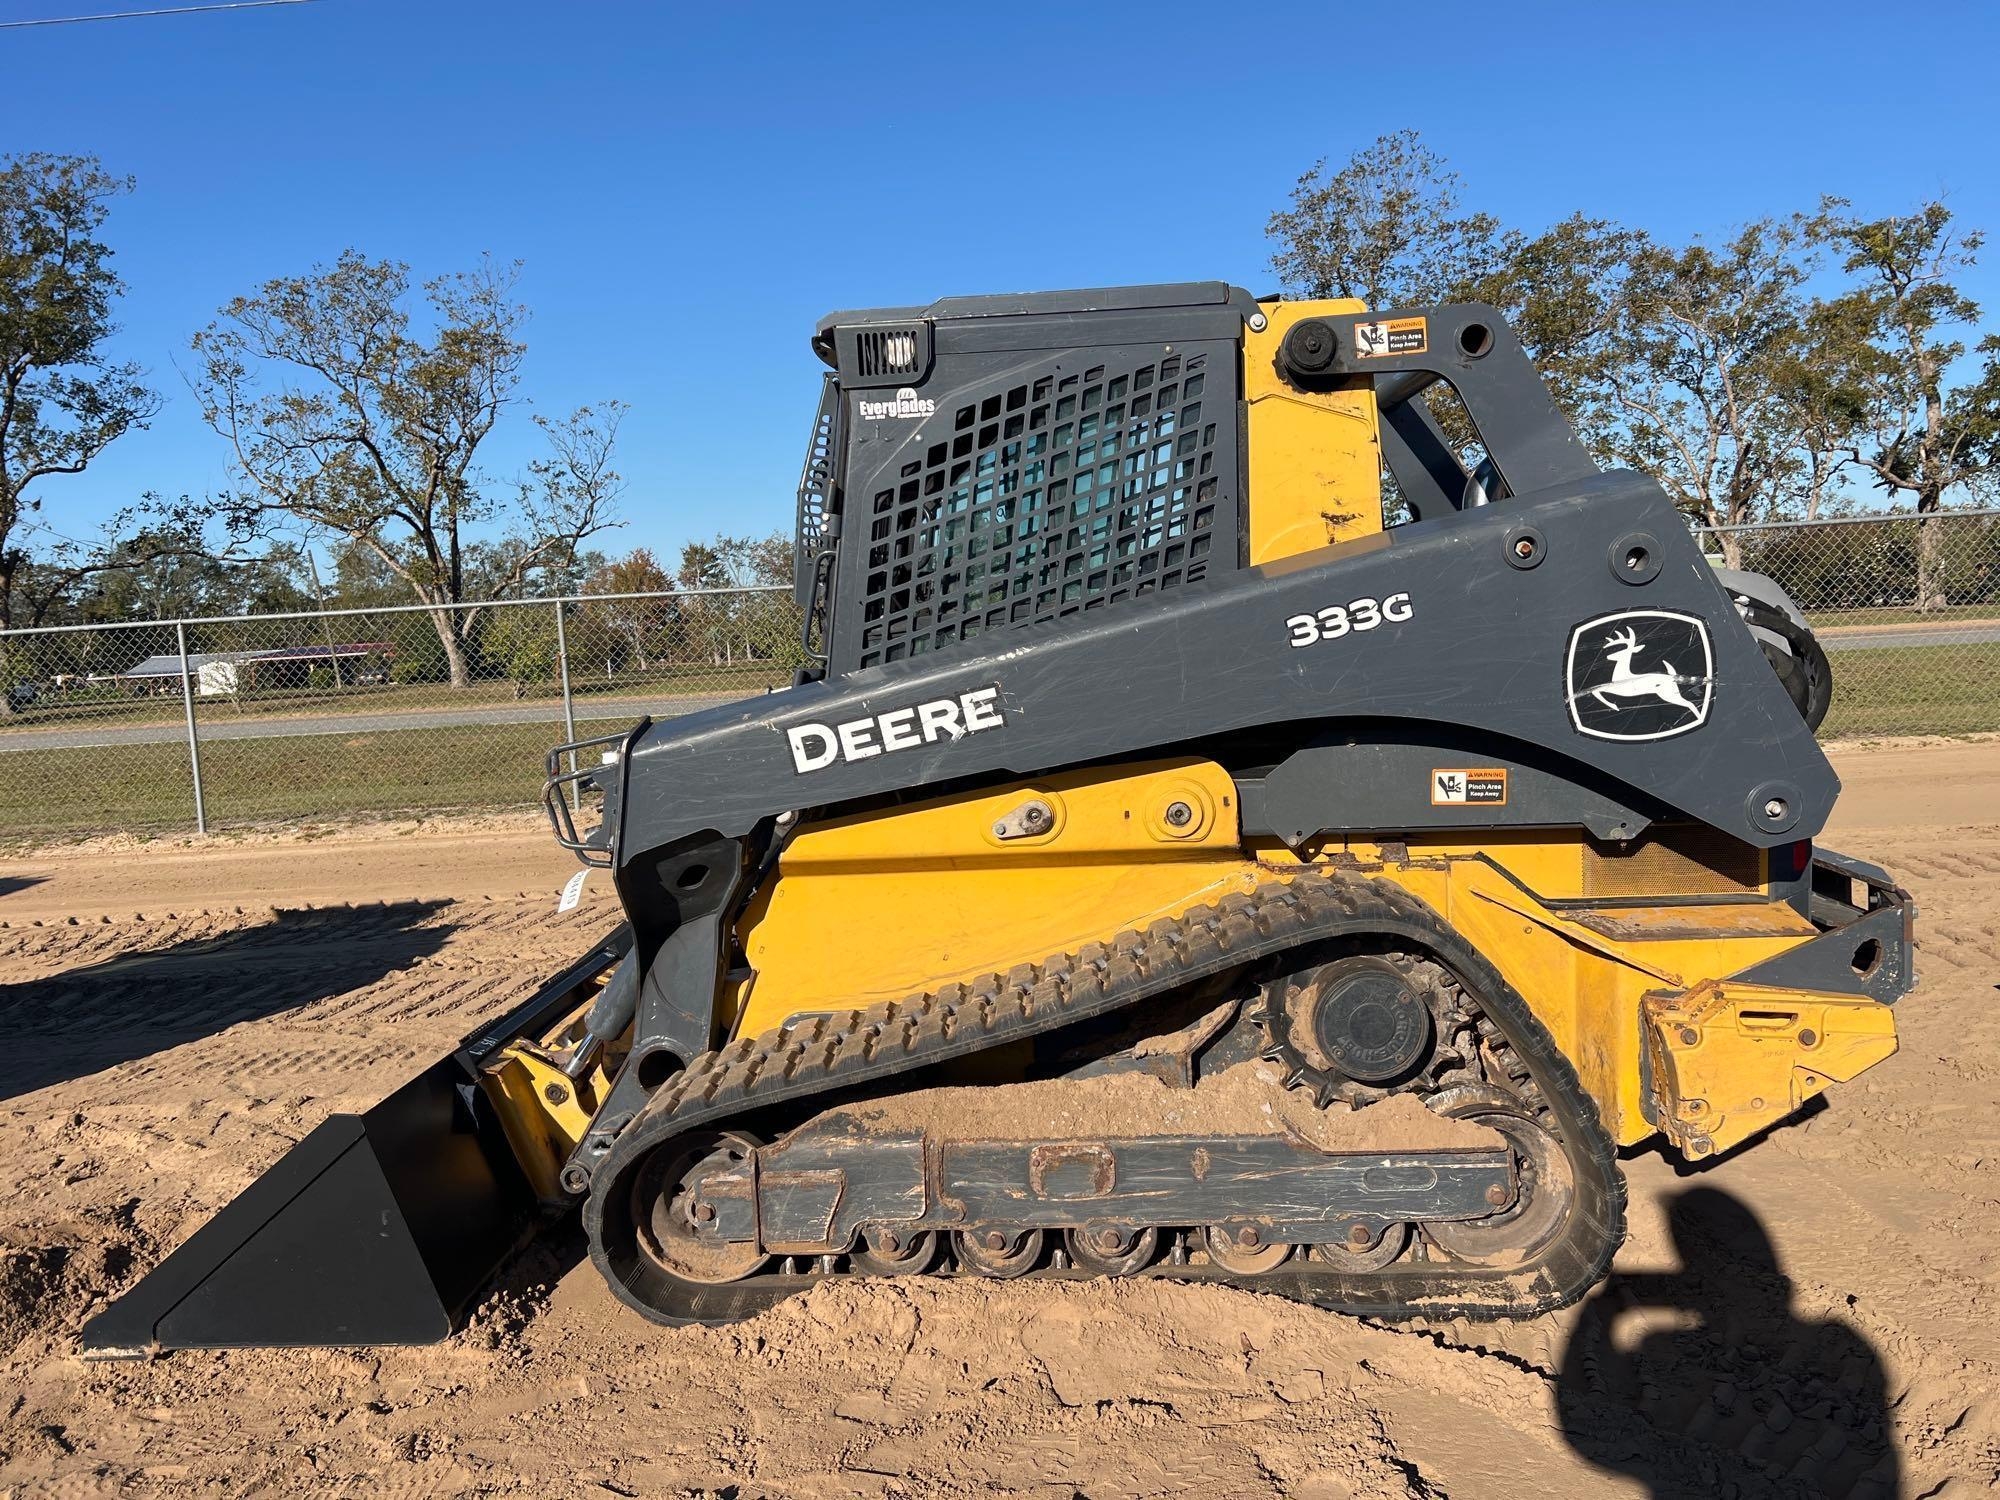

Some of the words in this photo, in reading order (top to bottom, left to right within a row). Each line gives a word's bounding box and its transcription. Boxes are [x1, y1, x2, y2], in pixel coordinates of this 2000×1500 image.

[1395, 321, 1423, 329] WARNING
[859, 398, 935, 418] Everglades
[1286, 592, 1414, 648] 333G
[787, 687, 1004, 774] DEERE
